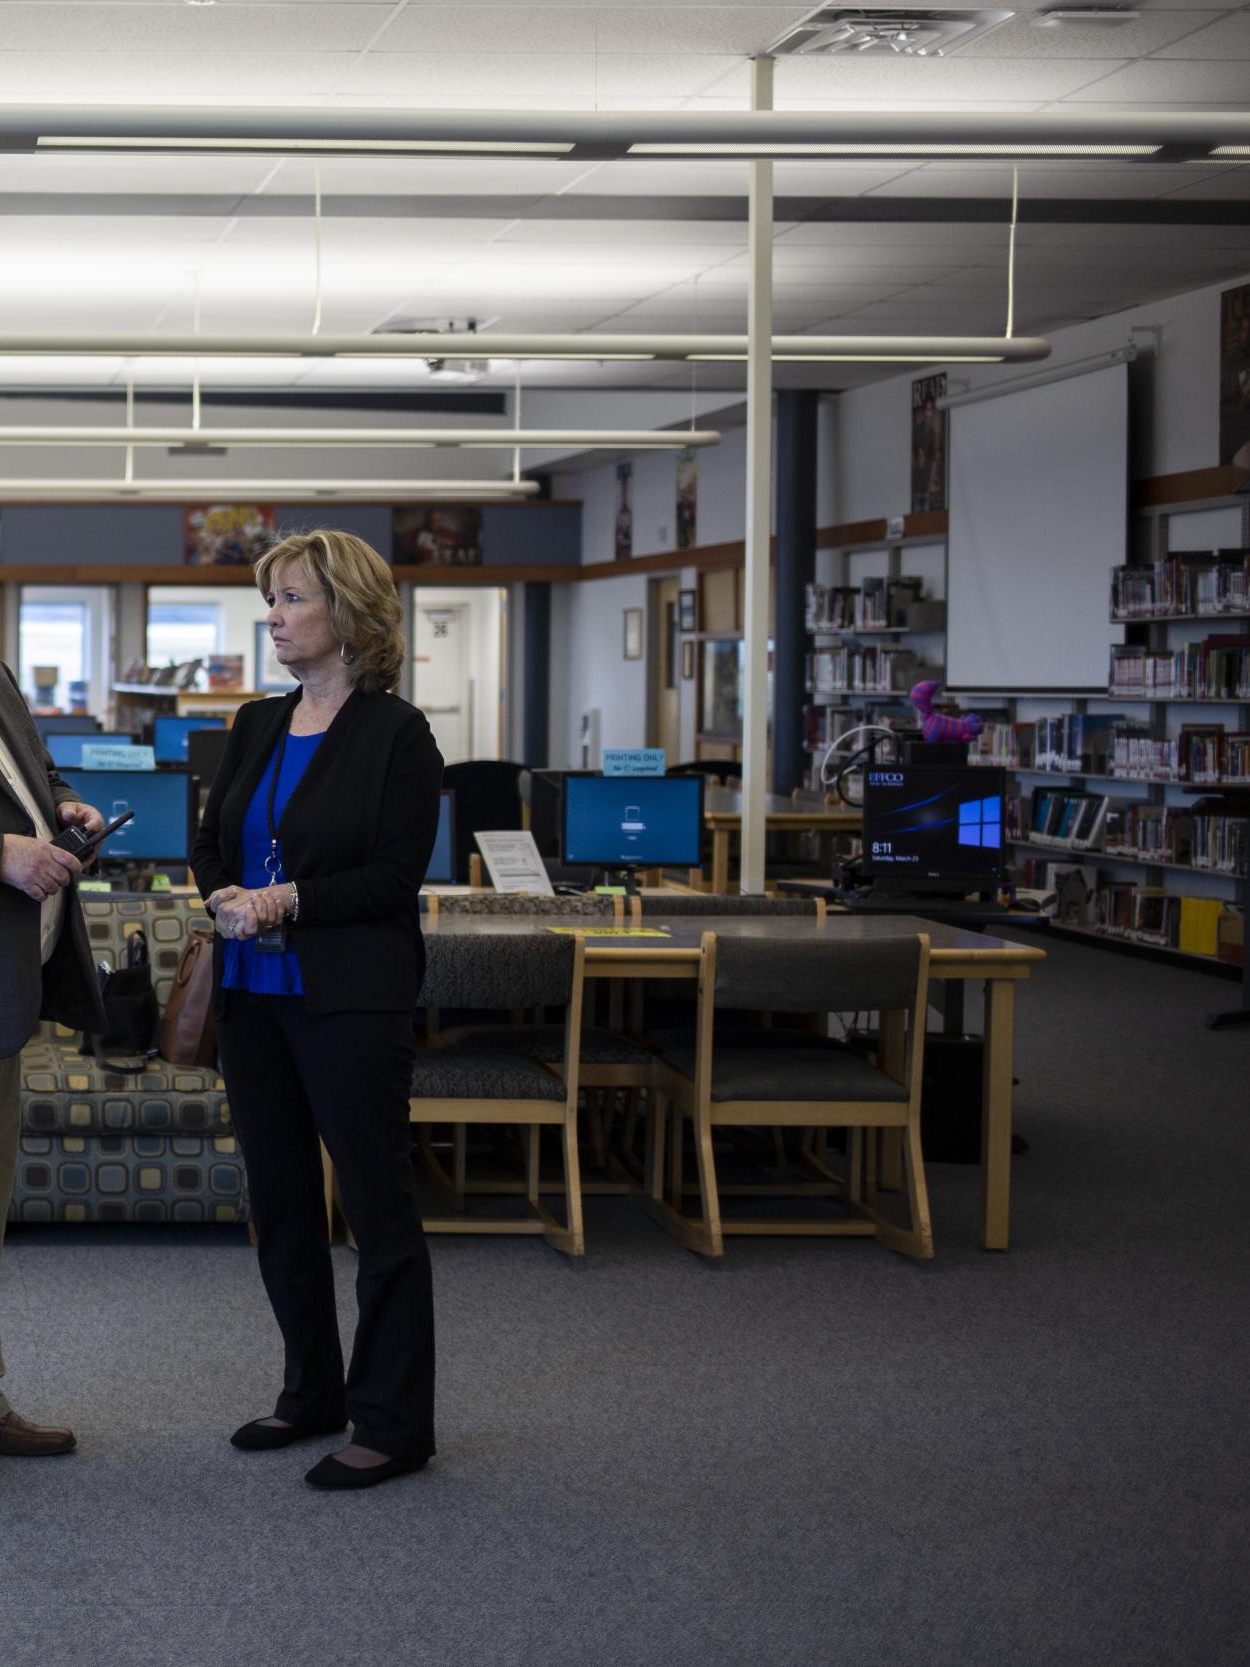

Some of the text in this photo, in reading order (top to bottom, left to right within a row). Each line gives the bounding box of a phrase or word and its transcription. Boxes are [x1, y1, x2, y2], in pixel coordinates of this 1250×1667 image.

[606, 753, 664, 762] PRINTING ONLY
[872, 841, 892, 854] 8:11
